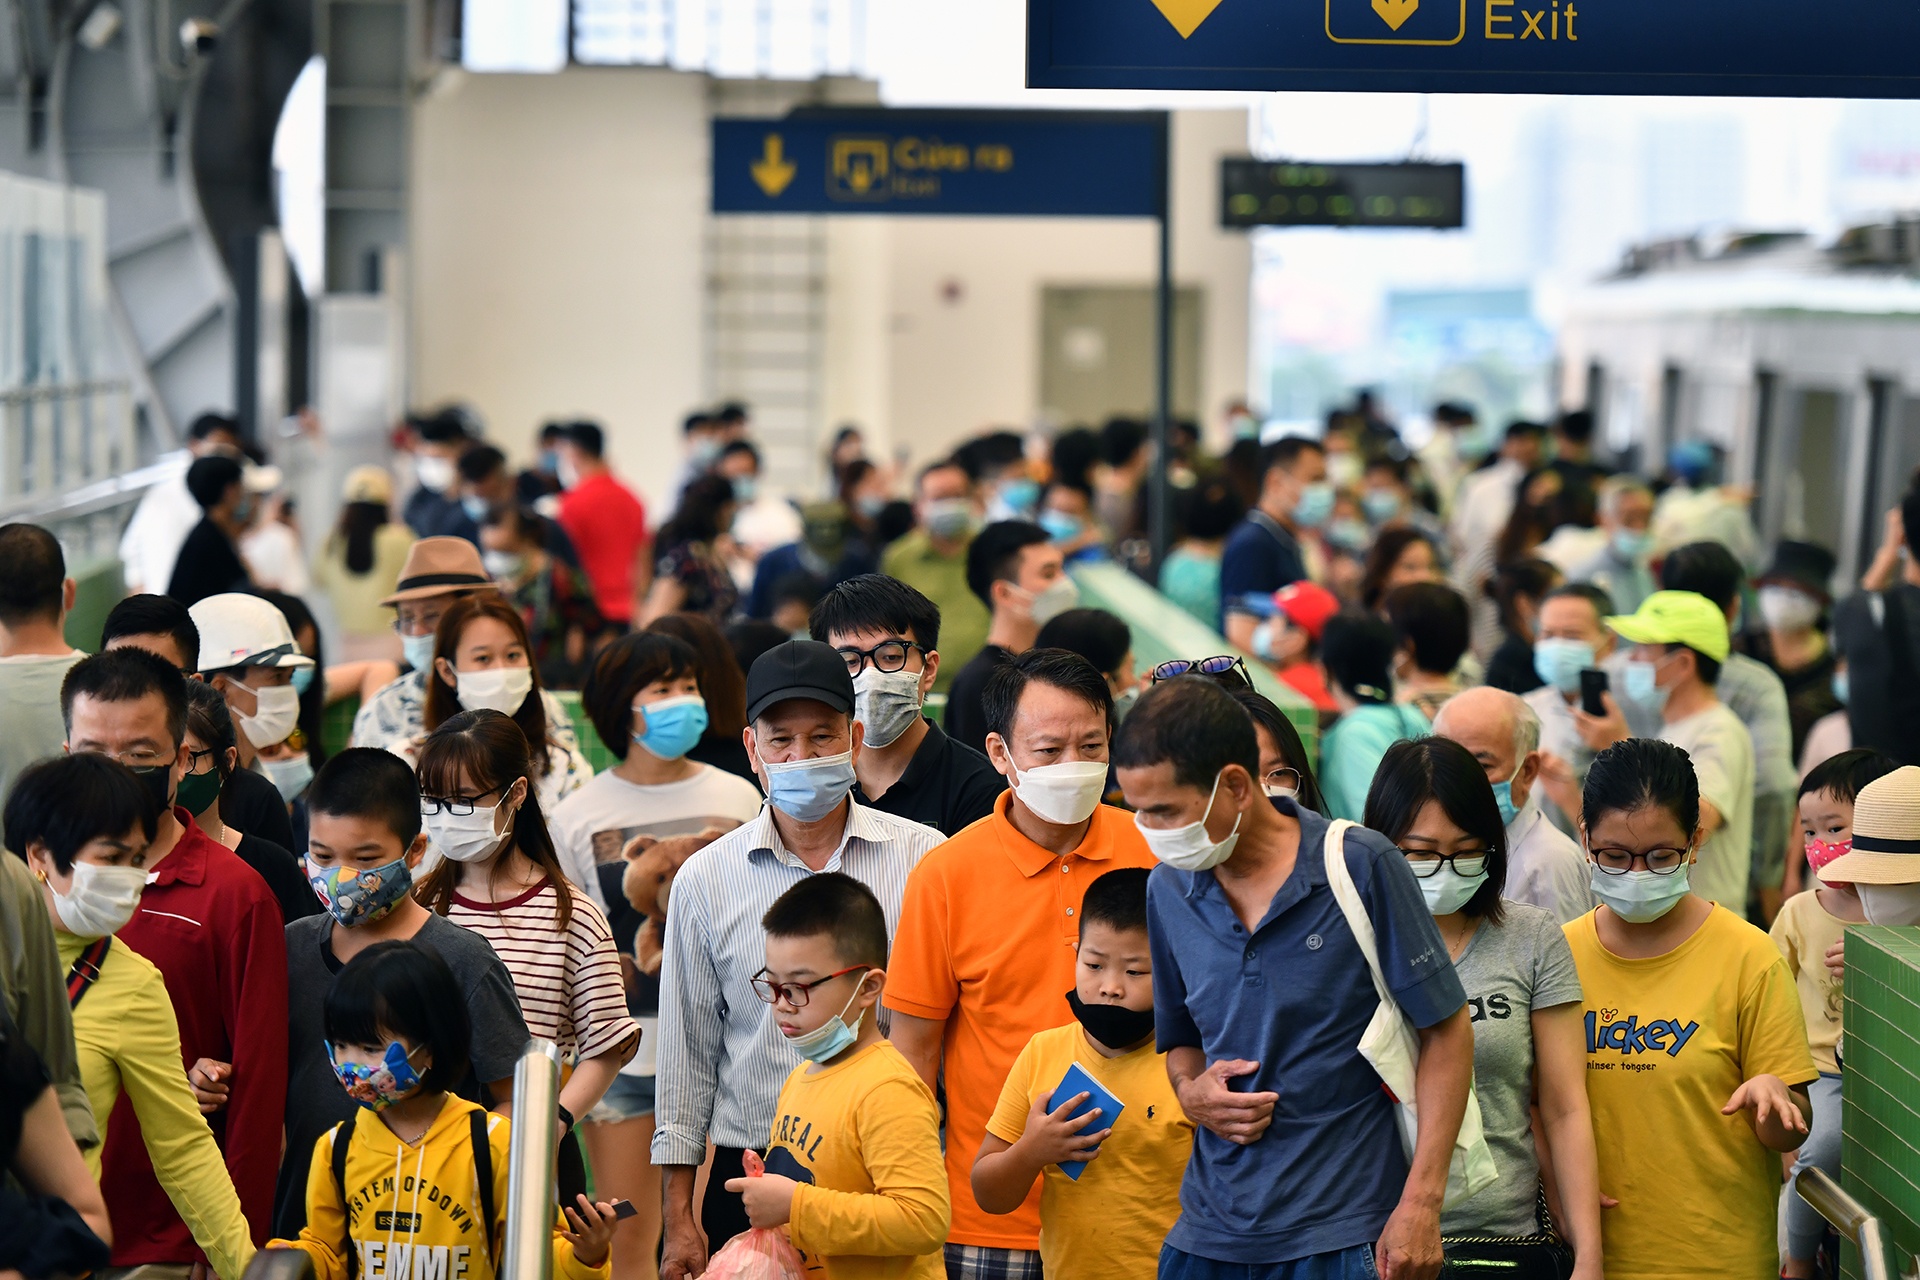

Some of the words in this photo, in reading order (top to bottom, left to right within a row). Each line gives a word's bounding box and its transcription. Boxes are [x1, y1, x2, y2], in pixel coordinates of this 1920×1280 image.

[1485, 0, 1578, 41] Exit
[1621, 1062, 1657, 1073] tongser
[404, 1176, 427, 1195] OF
[428, 1185, 473, 1234] DOWN
